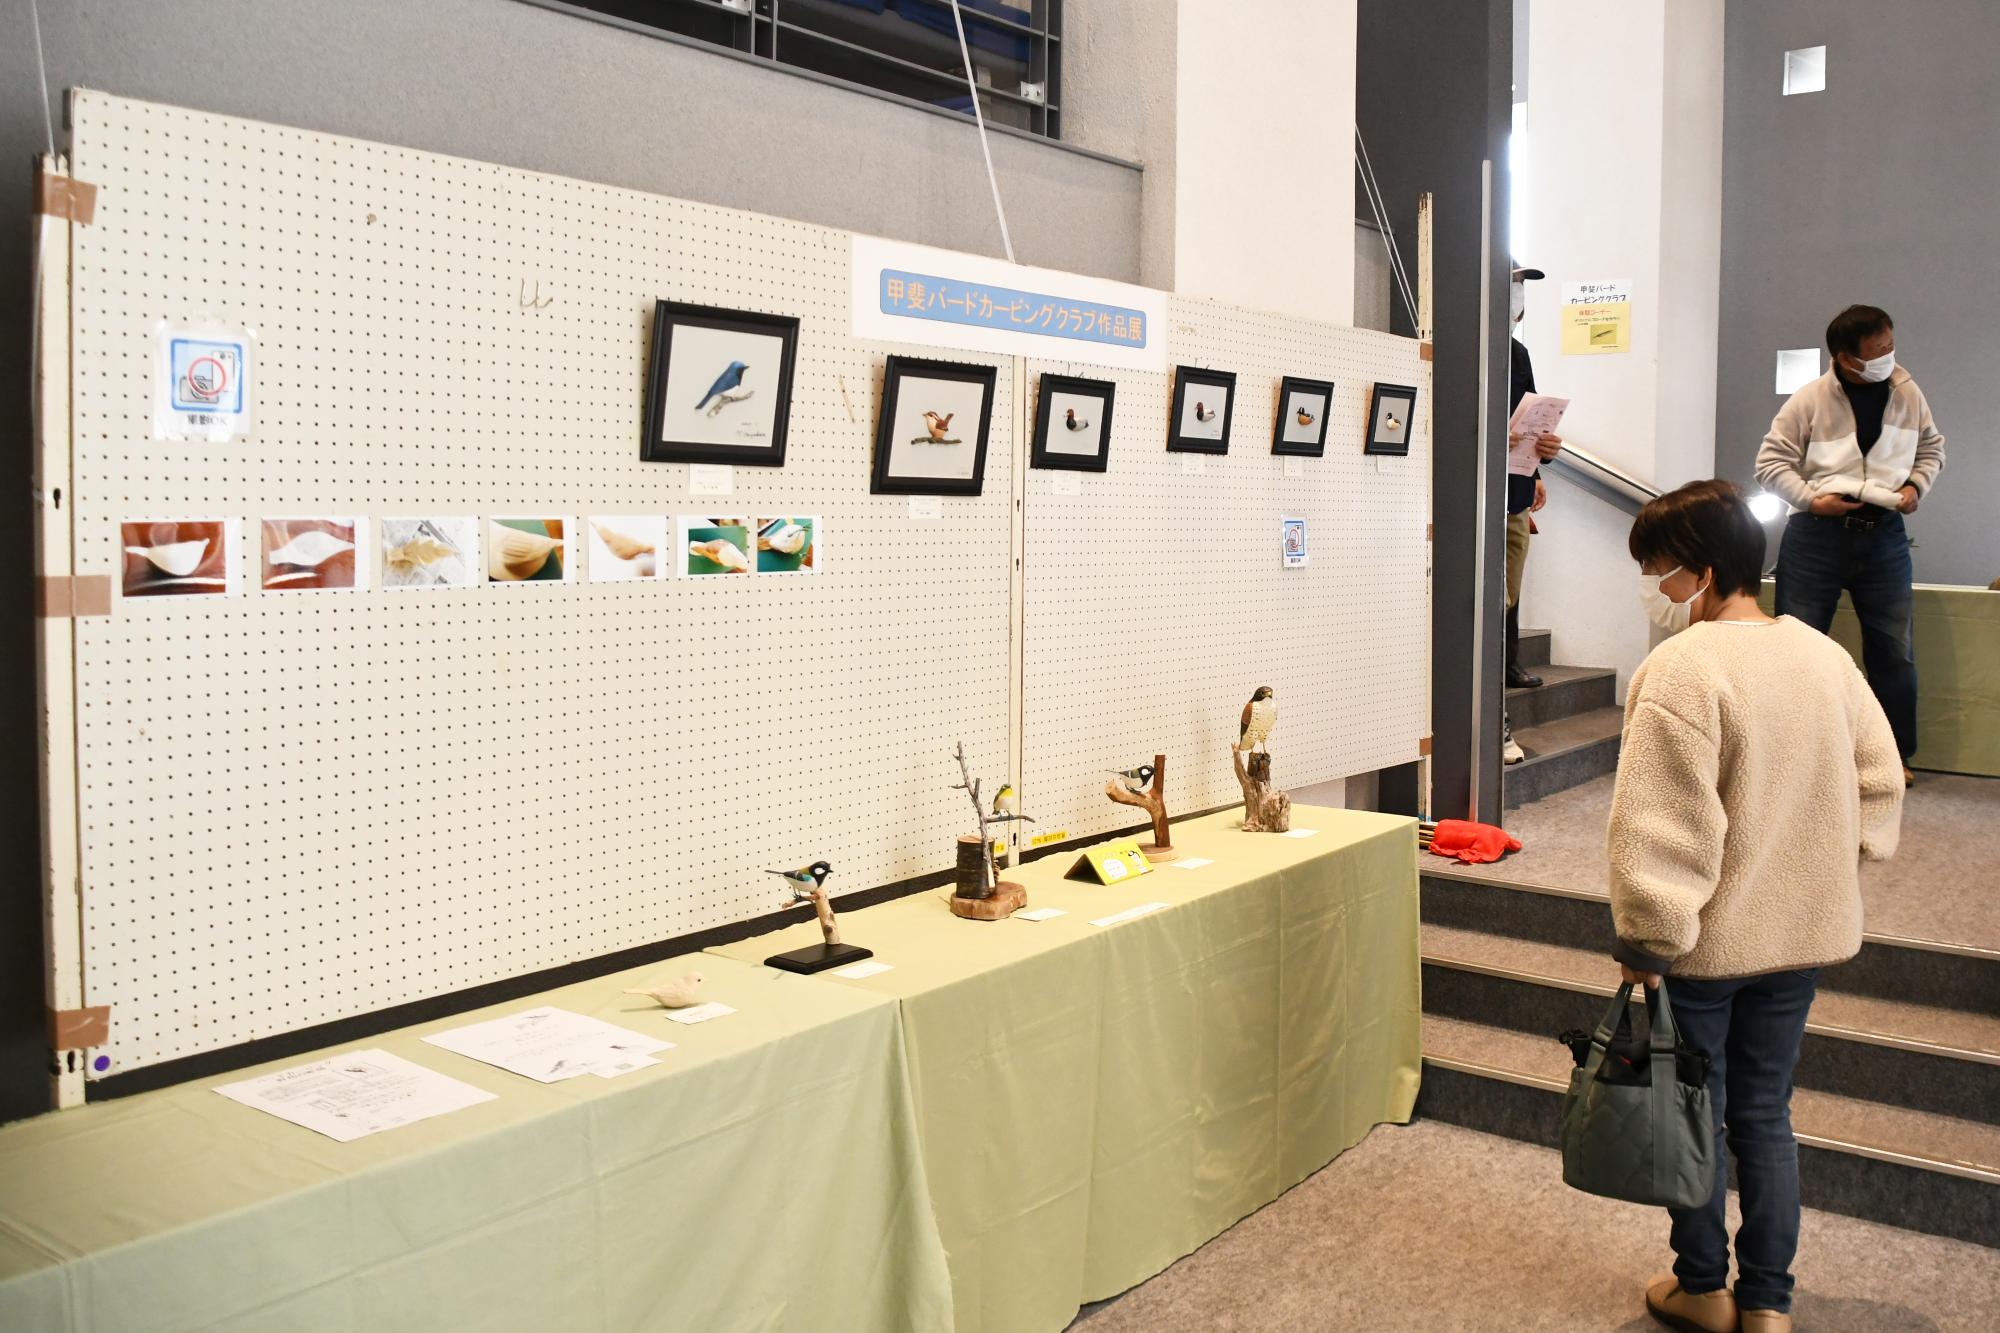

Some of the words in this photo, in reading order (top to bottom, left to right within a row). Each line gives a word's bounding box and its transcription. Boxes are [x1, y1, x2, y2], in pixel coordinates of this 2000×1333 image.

[1580, 284, 1616, 294] 甲斐バード
[886, 278, 1143, 342] 甲斐バードカービングクラブ作品展
